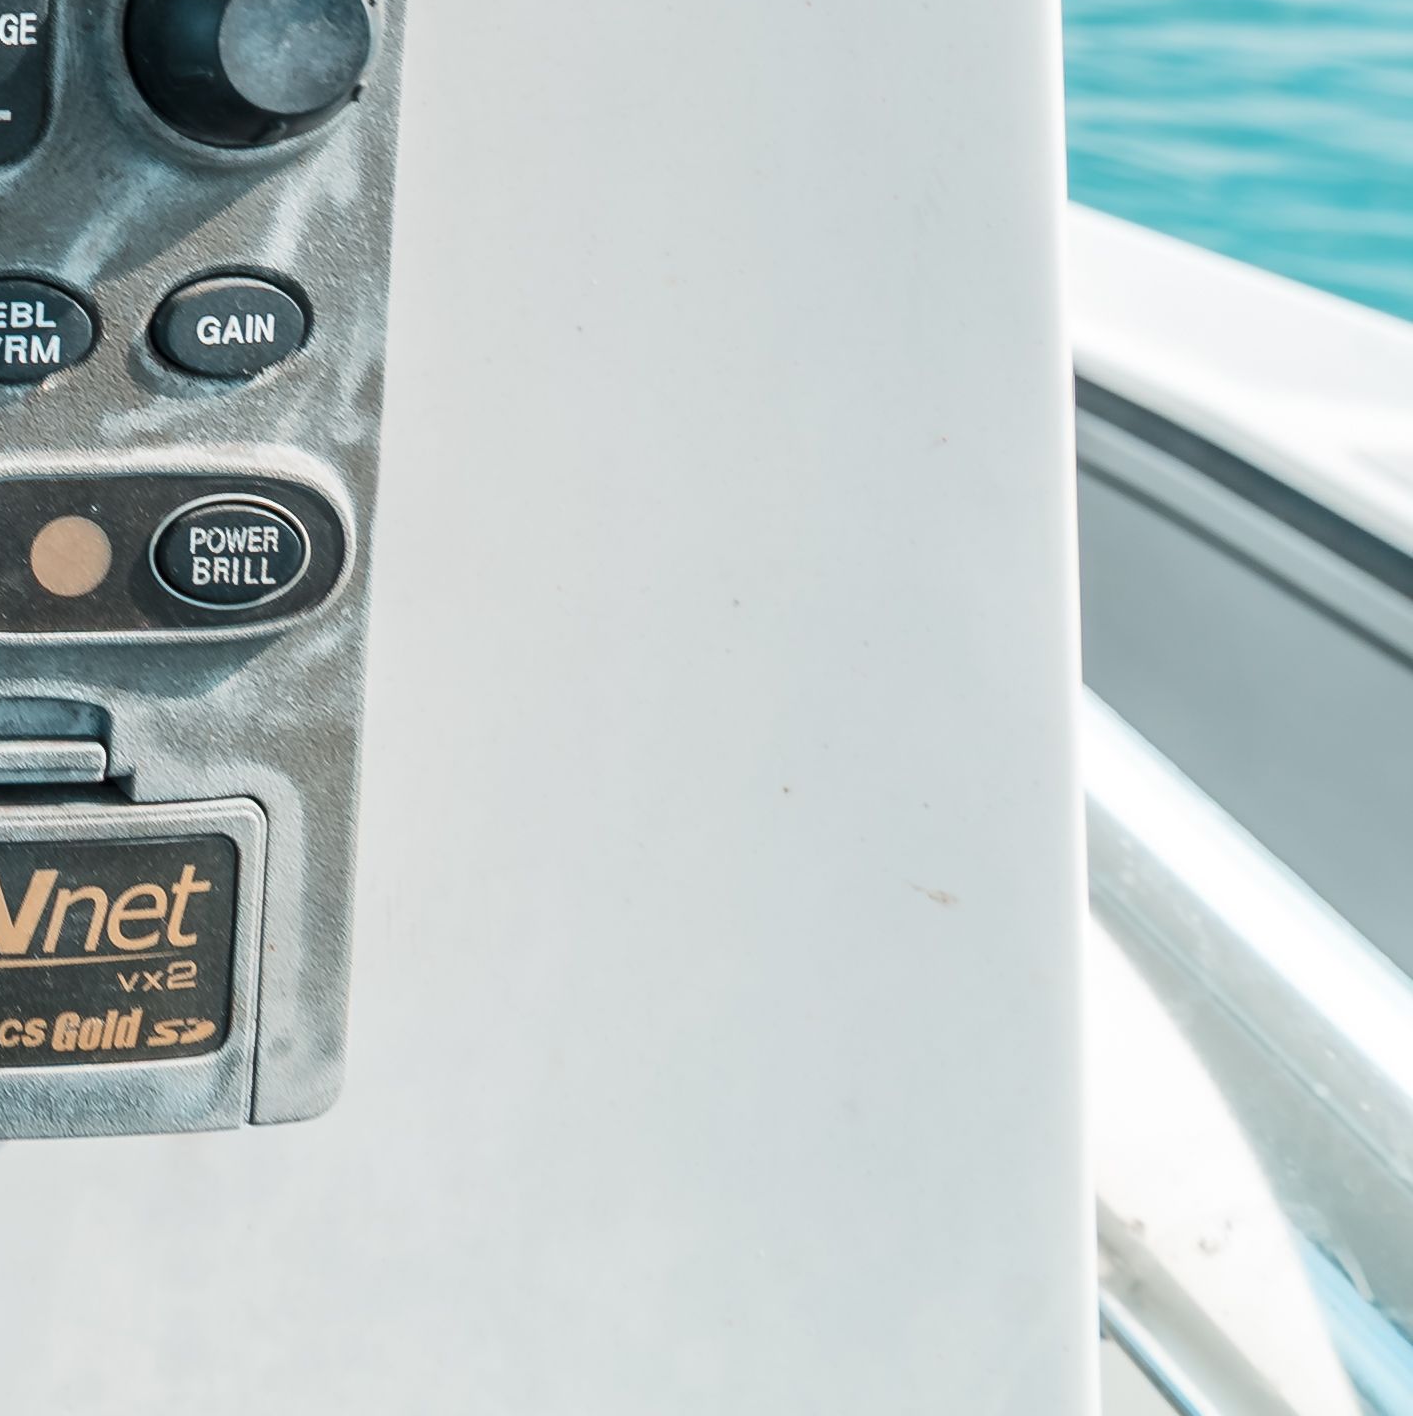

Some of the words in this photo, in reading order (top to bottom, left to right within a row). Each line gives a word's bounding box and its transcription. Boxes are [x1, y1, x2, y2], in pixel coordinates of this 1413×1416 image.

[197, 315, 276, 345] GAIN
[189, 526, 280, 553] POWER
[192, 556, 277, 586] BRILL
[51, 1005, 145, 1053] Gold
